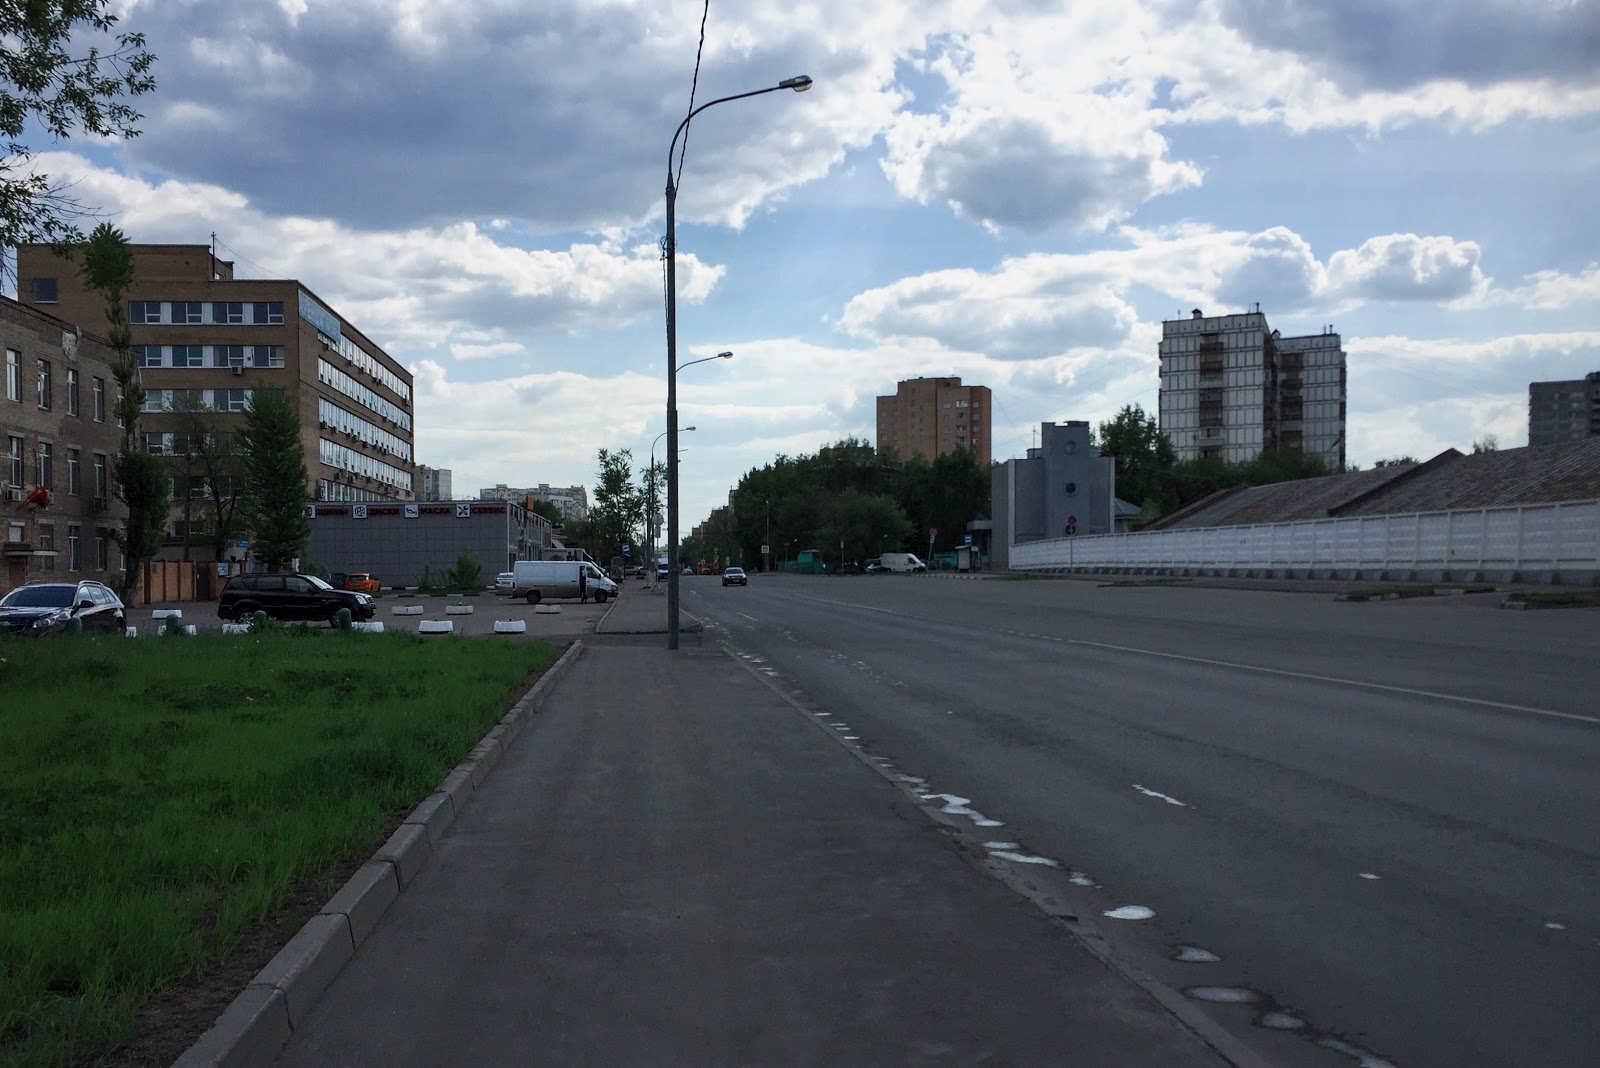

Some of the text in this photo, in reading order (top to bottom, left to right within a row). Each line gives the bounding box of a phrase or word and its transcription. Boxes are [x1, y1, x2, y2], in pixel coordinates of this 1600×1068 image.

[368, 507, 400, 516] ДИСКИ
[419, 507, 452, 515] МАСЛА
[472, 506, 506, 514] СЕРВИС
